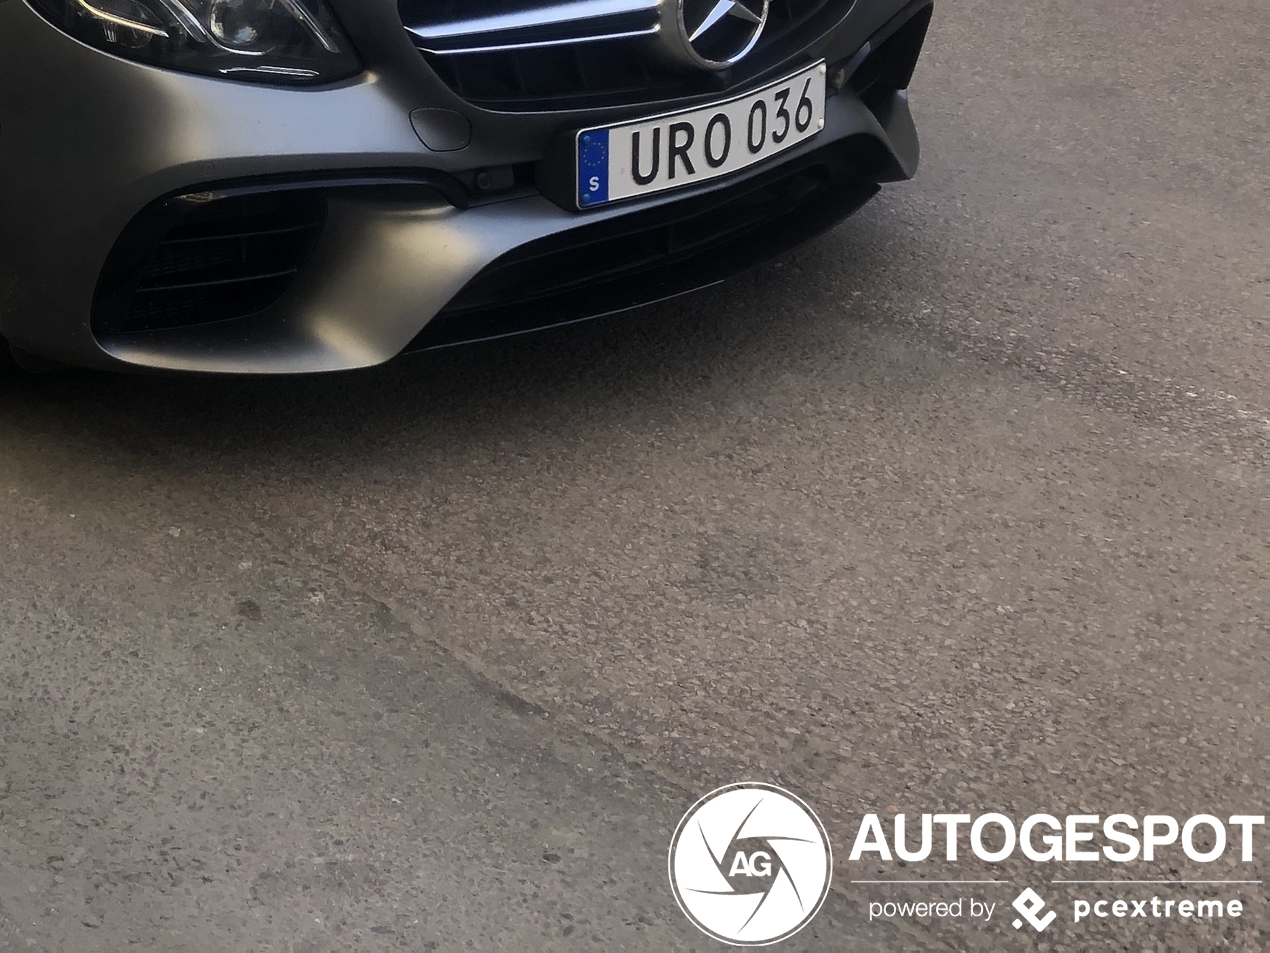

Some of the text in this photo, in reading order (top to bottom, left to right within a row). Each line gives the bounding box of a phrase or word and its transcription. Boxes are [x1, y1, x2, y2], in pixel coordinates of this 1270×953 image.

[588, 77, 813, 192] S URO 036
